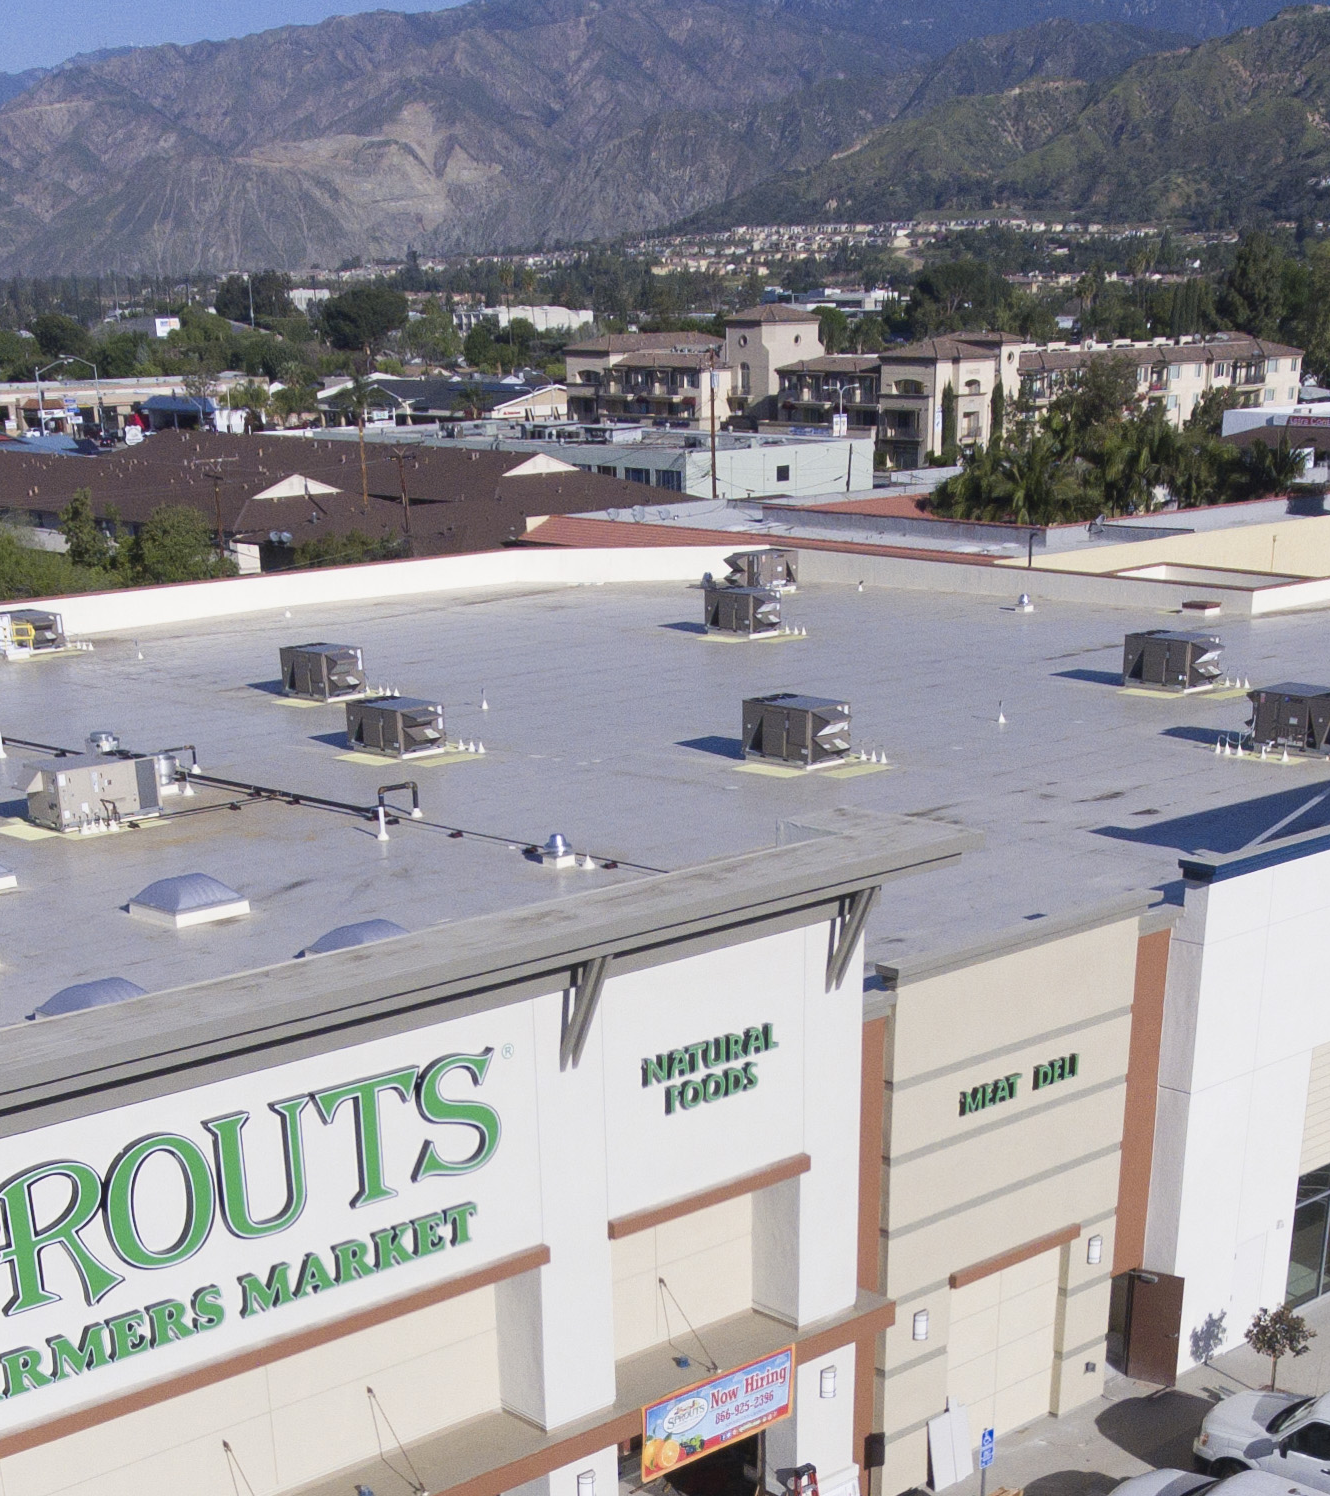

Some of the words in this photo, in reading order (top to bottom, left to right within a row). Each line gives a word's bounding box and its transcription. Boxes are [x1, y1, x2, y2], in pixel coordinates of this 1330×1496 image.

[640, 1022, 780, 1088] NATURAL
[958, 1072, 1023, 1117] MEAT
[1032, 1053, 1080, 1091] DELI
[664, 1061, 760, 1116] FOODS
[238, 1200, 480, 1318] MARKET
[710, 1386, 739, 1410] Now
[744, 1366, 788, 1395] Hiring
